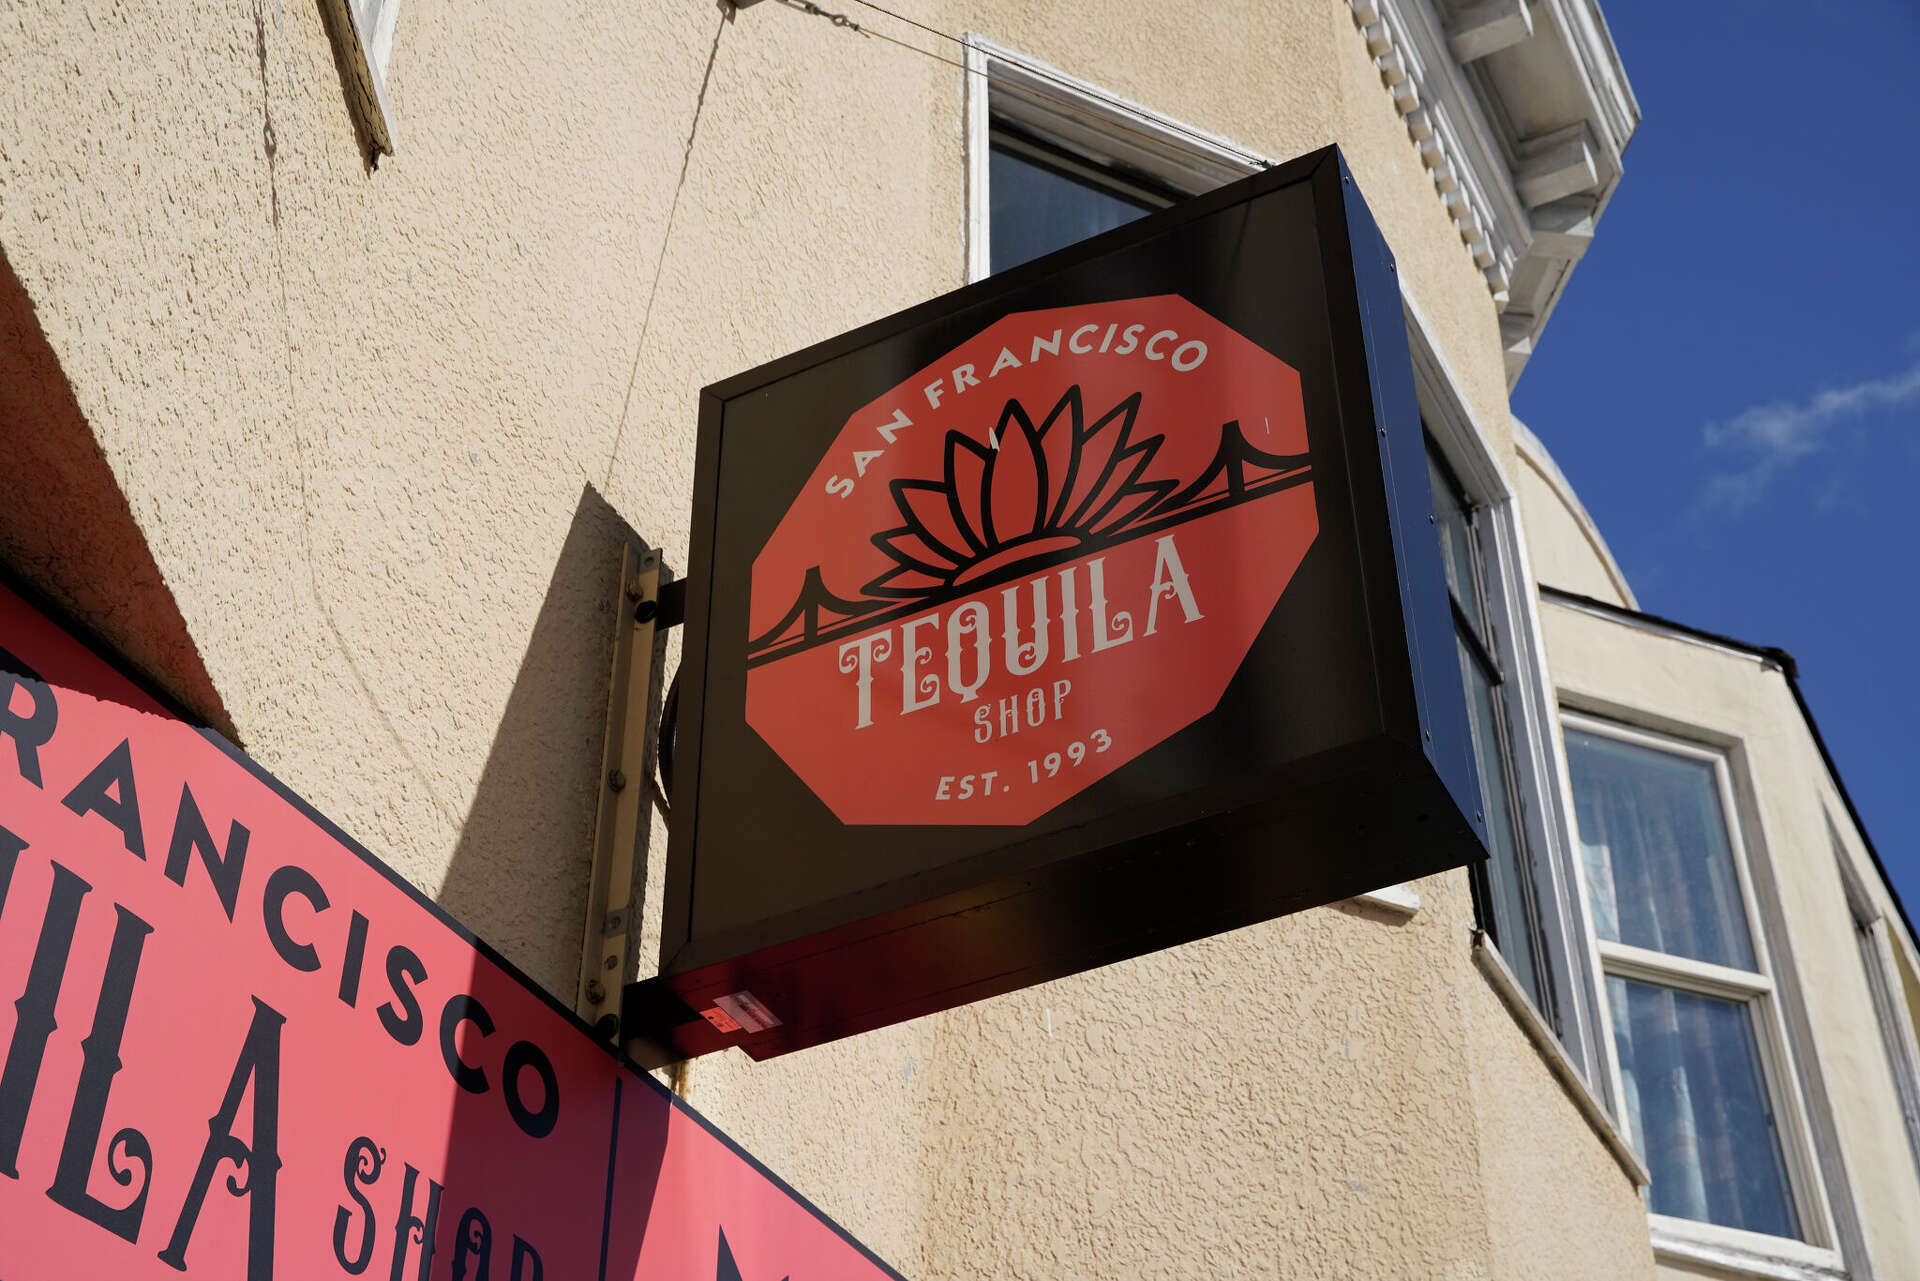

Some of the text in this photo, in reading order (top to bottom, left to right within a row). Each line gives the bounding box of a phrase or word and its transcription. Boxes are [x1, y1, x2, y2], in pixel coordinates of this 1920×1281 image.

[825, 323, 1208, 499] SAN FRANCISCO
[838, 533, 1205, 730] TEQUILA
[935, 728, 1113, 801] EST. 1993
[973, 679, 1072, 744] SHOP
